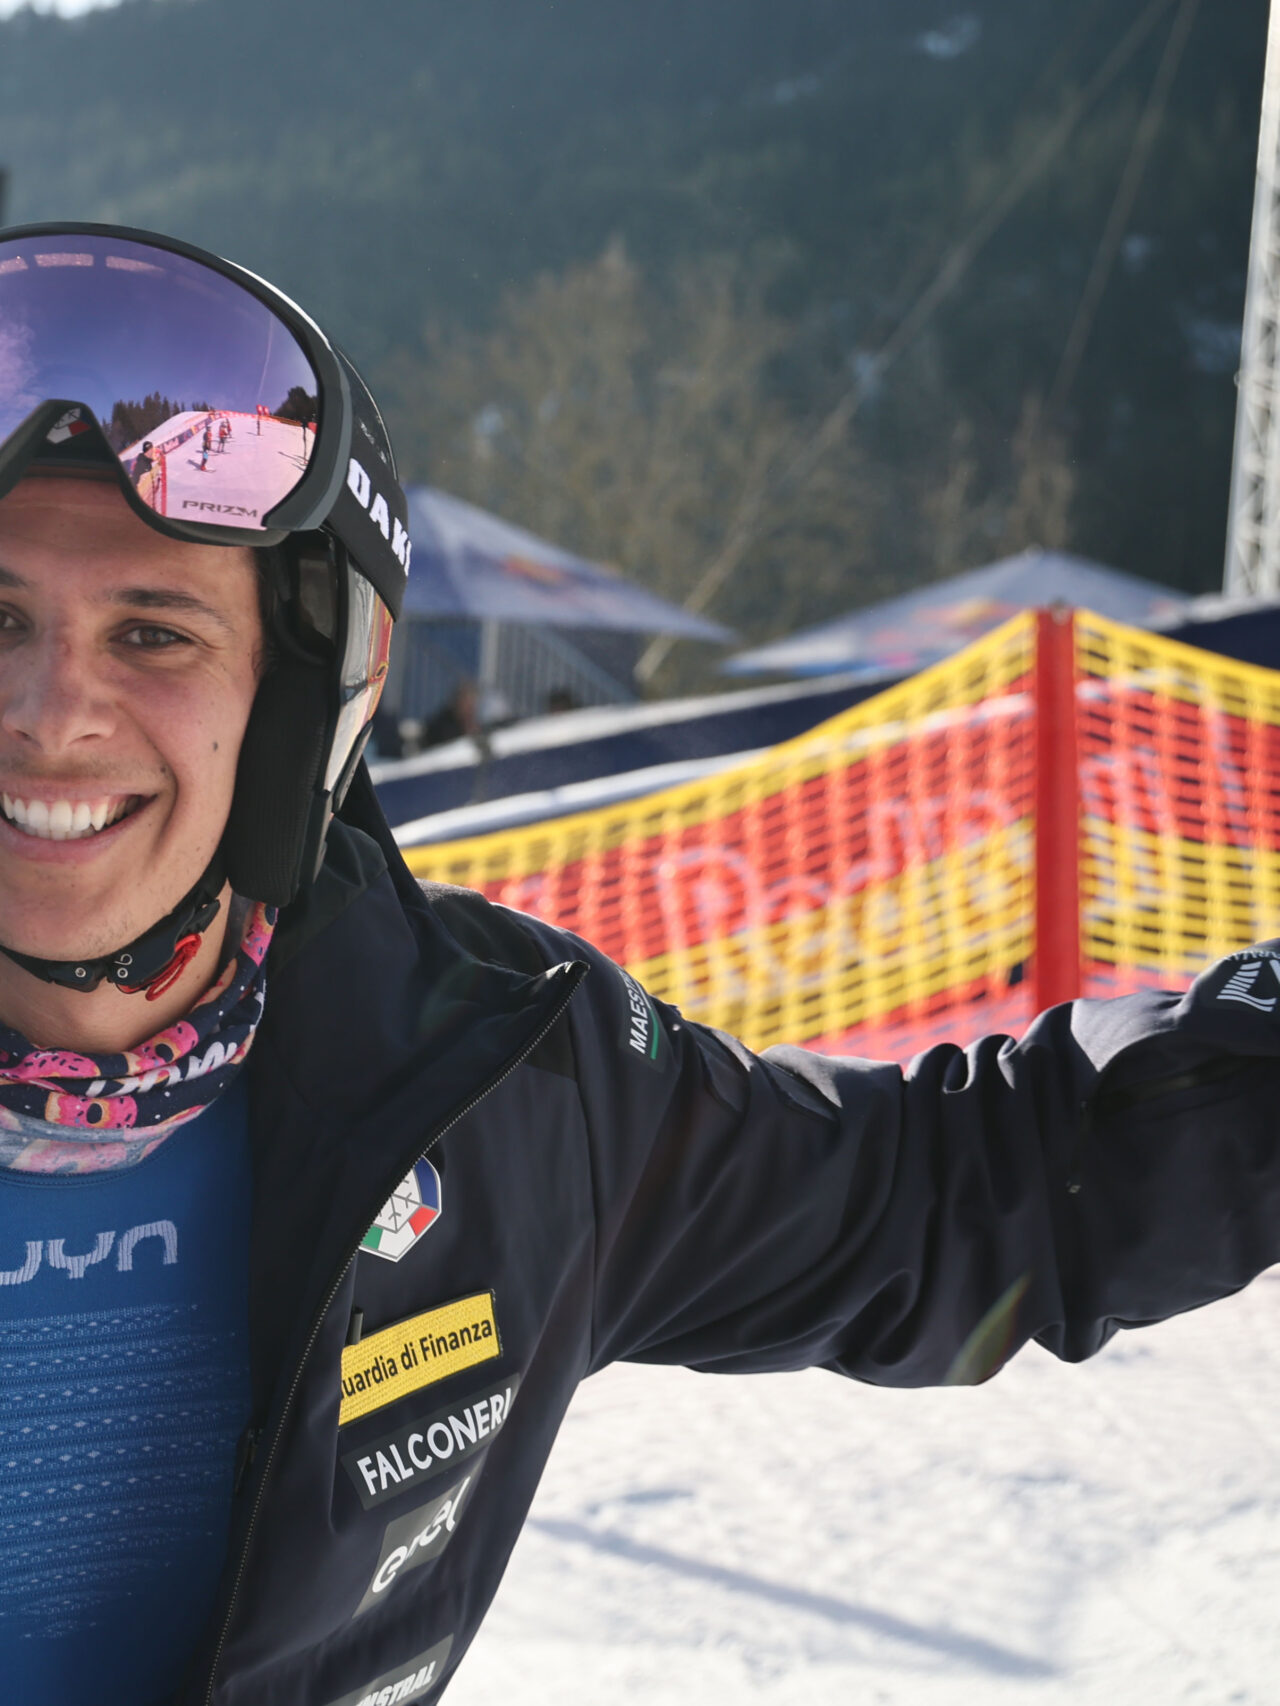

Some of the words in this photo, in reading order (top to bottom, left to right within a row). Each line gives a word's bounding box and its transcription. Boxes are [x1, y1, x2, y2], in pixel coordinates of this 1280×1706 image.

[181, 499, 258, 519] PRIZM
[341, 1354, 399, 1398] uardia
[400, 1341, 419, 1371] di
[419, 1318, 493, 1362] Finanza
[356, 1386, 512, 1496] FALCONERI
